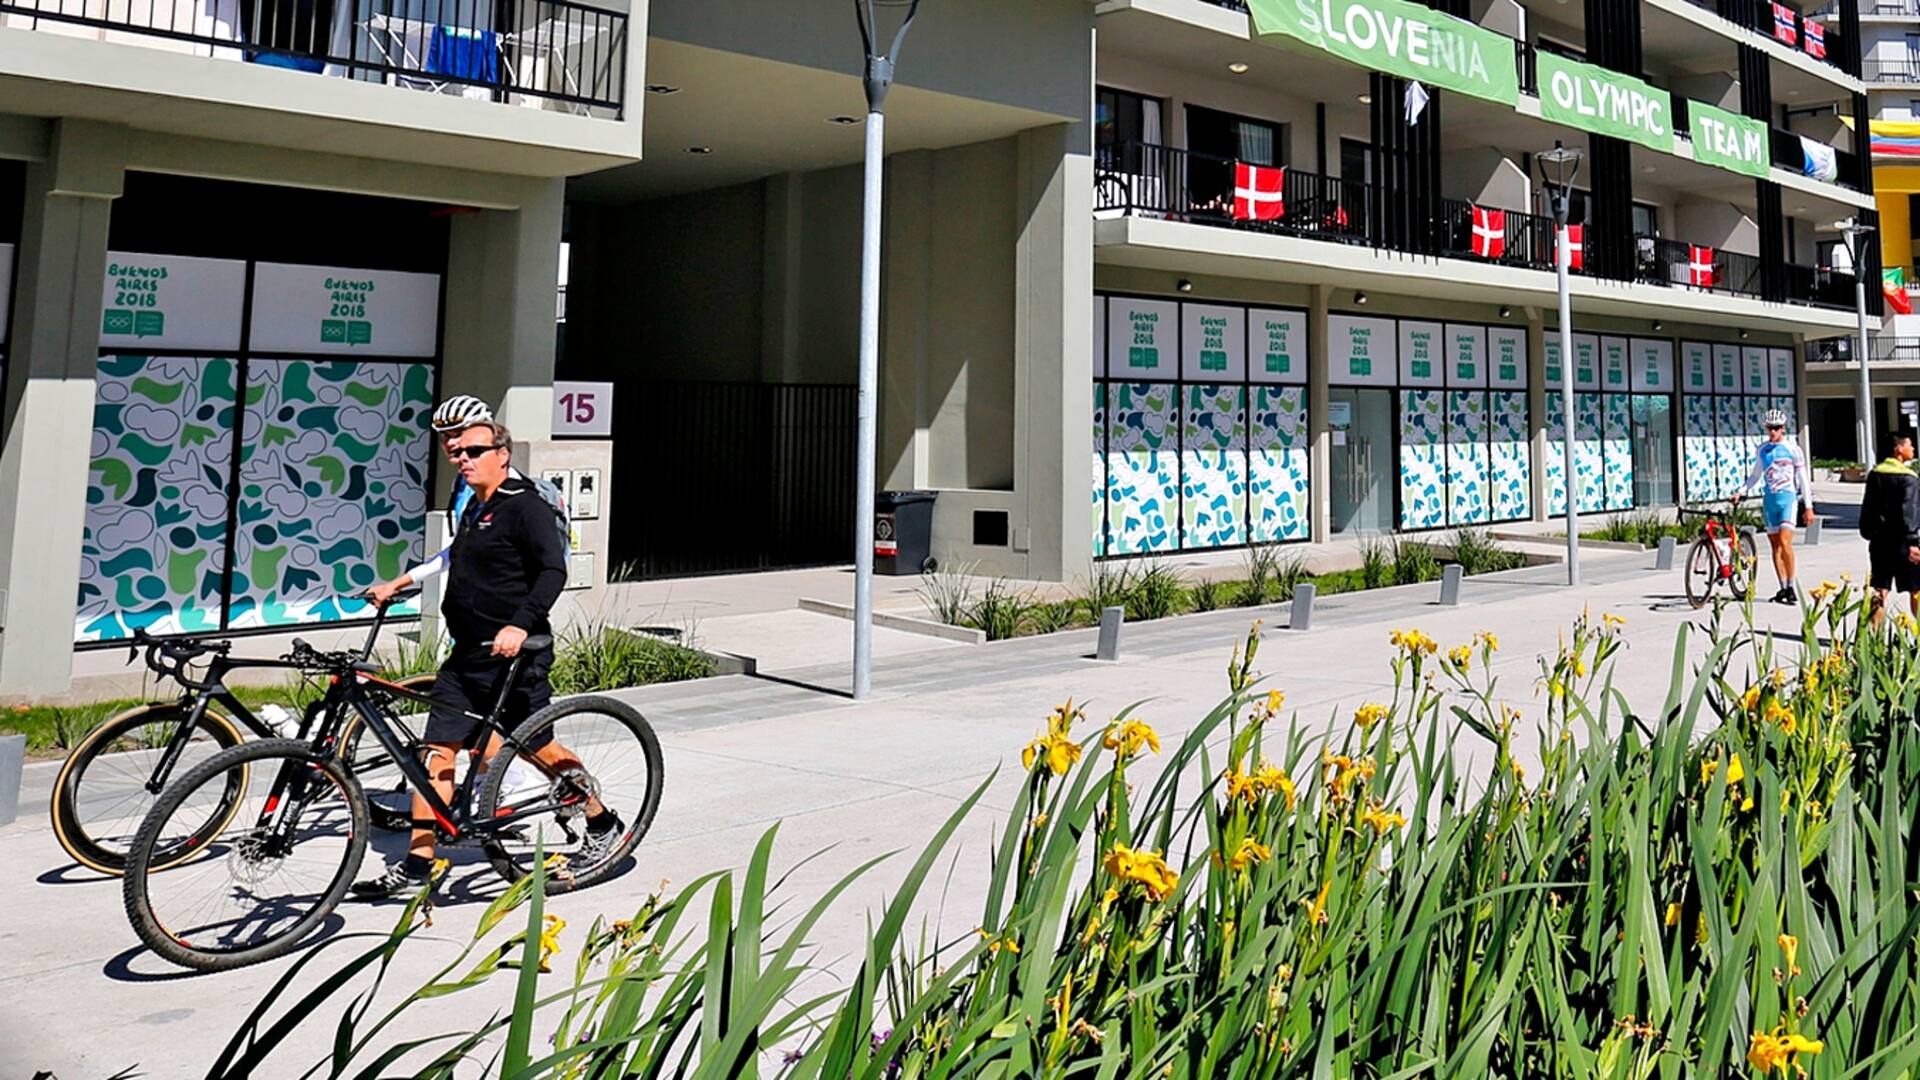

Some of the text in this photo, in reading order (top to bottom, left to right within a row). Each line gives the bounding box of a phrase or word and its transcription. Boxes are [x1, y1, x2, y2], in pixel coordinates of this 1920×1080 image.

[1295, 0, 1490, 85] SLOVENIA
[1551, 70, 1665, 136] OLYMPIC
[1699, 117, 1763, 165] TEAM
[108, 263, 168, 279] BUENOS
[115, 278, 158, 291] AIRES
[324, 278, 374, 292] BUENOS
[115, 292, 157, 307] 2018
[330, 291, 366, 304] AIRES
[330, 304, 366, 318] 2018
[1129, 311, 1159, 322] BUENOS
[1134, 333, 1154, 345] 2018
[559, 393, 595, 424] 15
